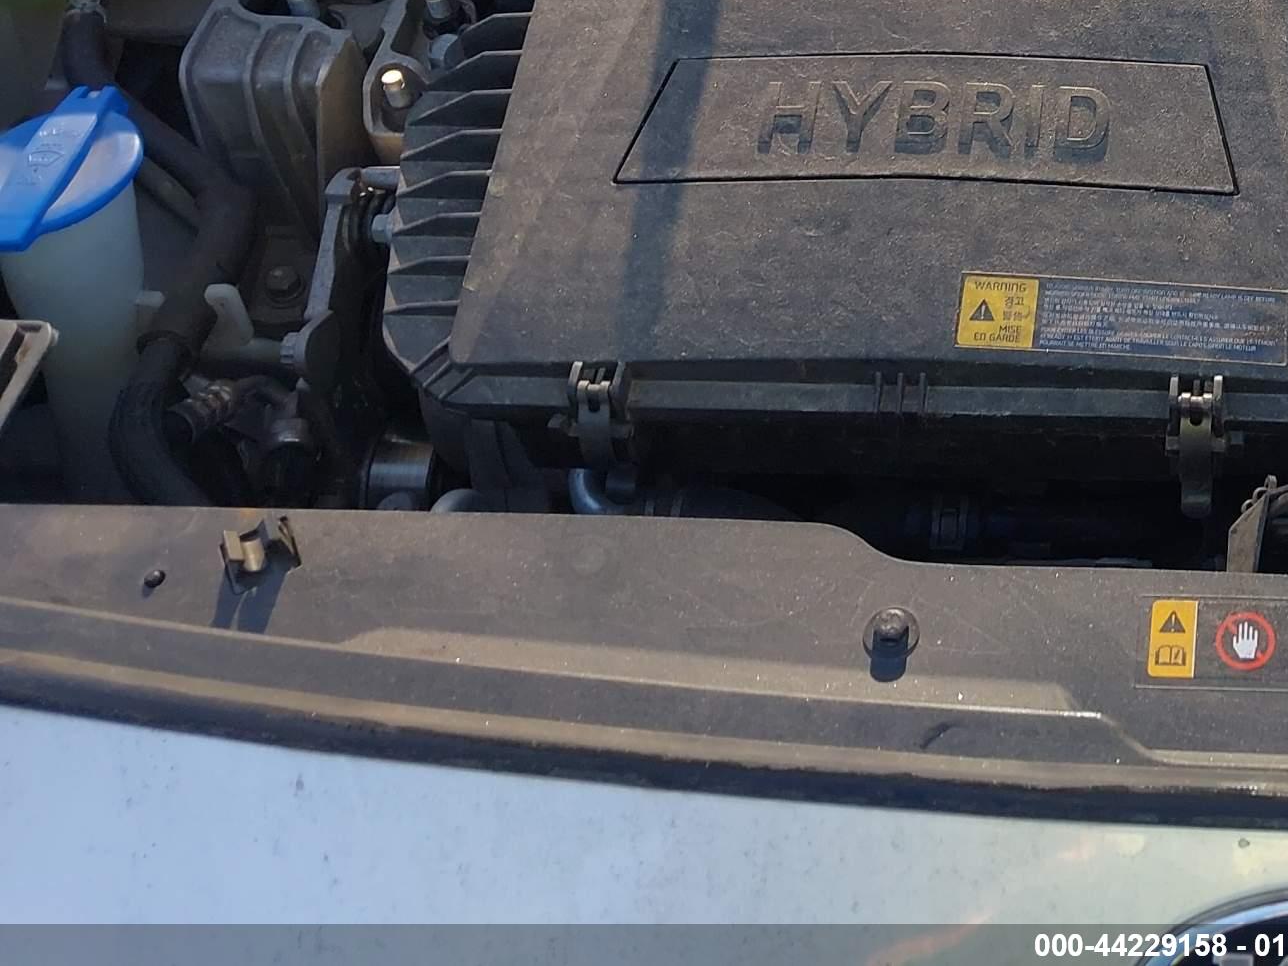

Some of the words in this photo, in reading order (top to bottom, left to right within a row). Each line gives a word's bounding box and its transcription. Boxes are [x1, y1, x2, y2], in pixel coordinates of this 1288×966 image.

[757, 80, 1112, 158] HYBRID
[975, 281, 1027, 292] WARNING
[1000, 325, 1022, 334] MISE
[973, 332, 986, 341] EN
[989, 333, 1020, 343] GARDE
